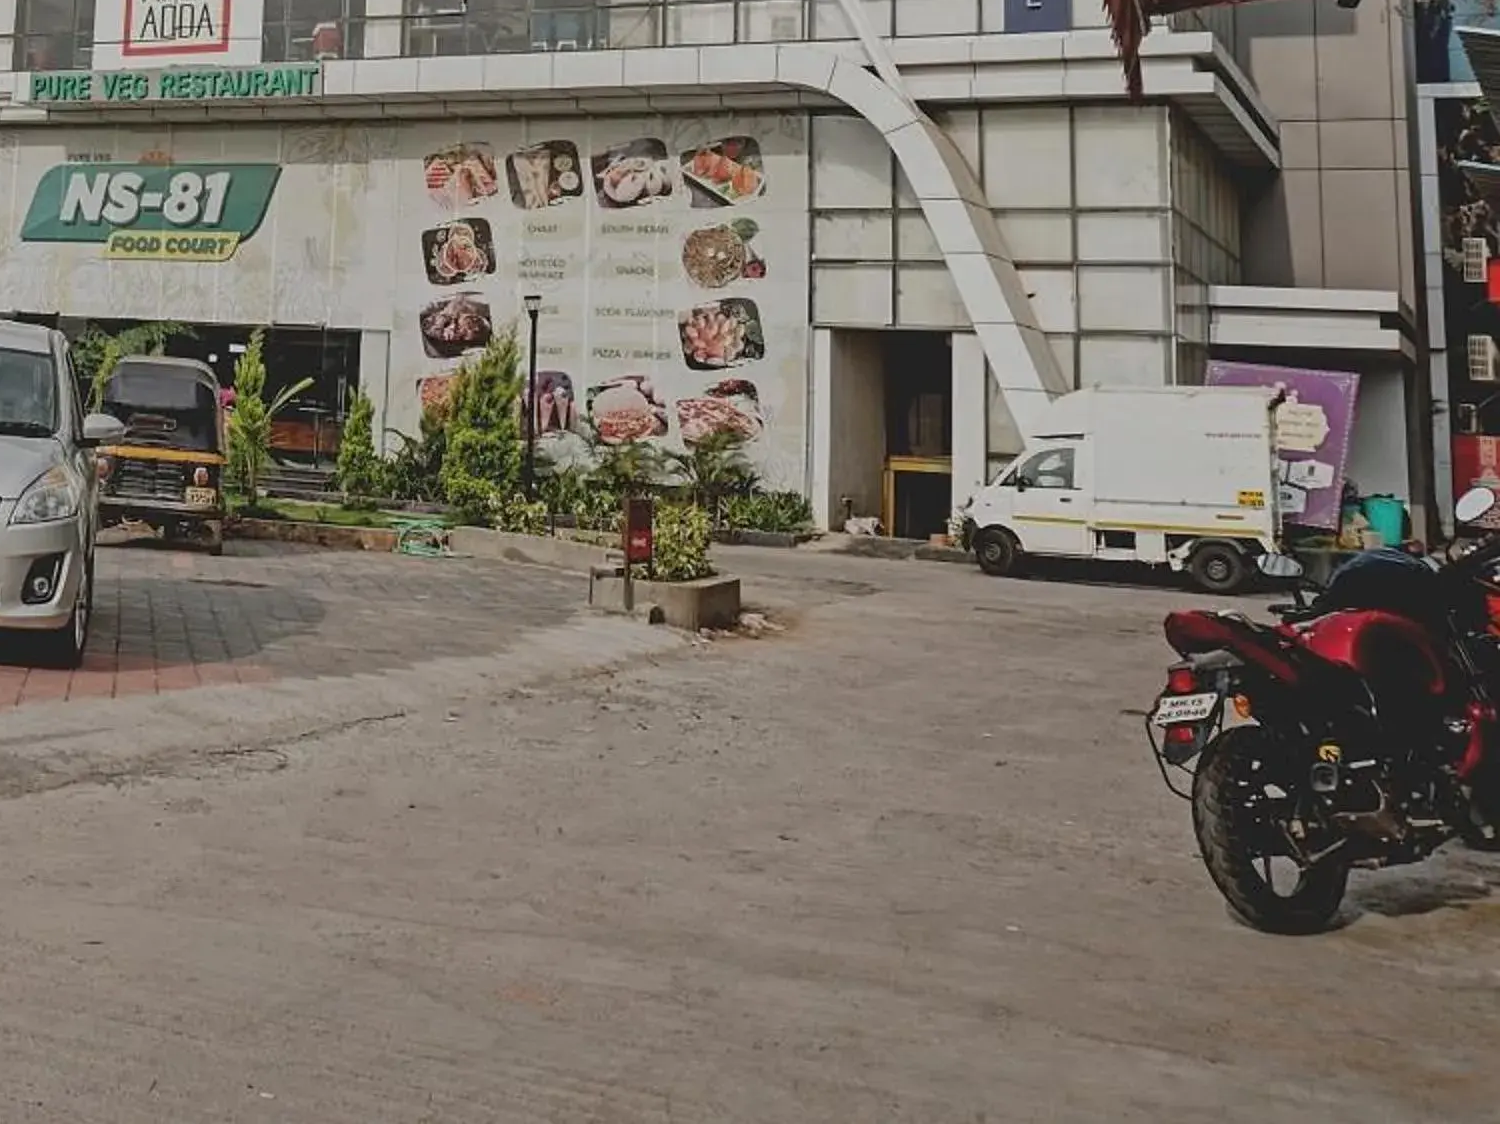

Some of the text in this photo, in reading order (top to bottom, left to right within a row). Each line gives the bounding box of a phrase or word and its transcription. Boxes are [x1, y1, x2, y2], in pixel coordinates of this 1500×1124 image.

[140, 3, 215, 40] ADDA
[31, 67, 320, 100] PURE VEG RESTAURANT
[59, 171, 232, 226] NS-81
[110, 236, 231, 255] FOOD COURT
[592, 348, 621, 359] PIZZA
